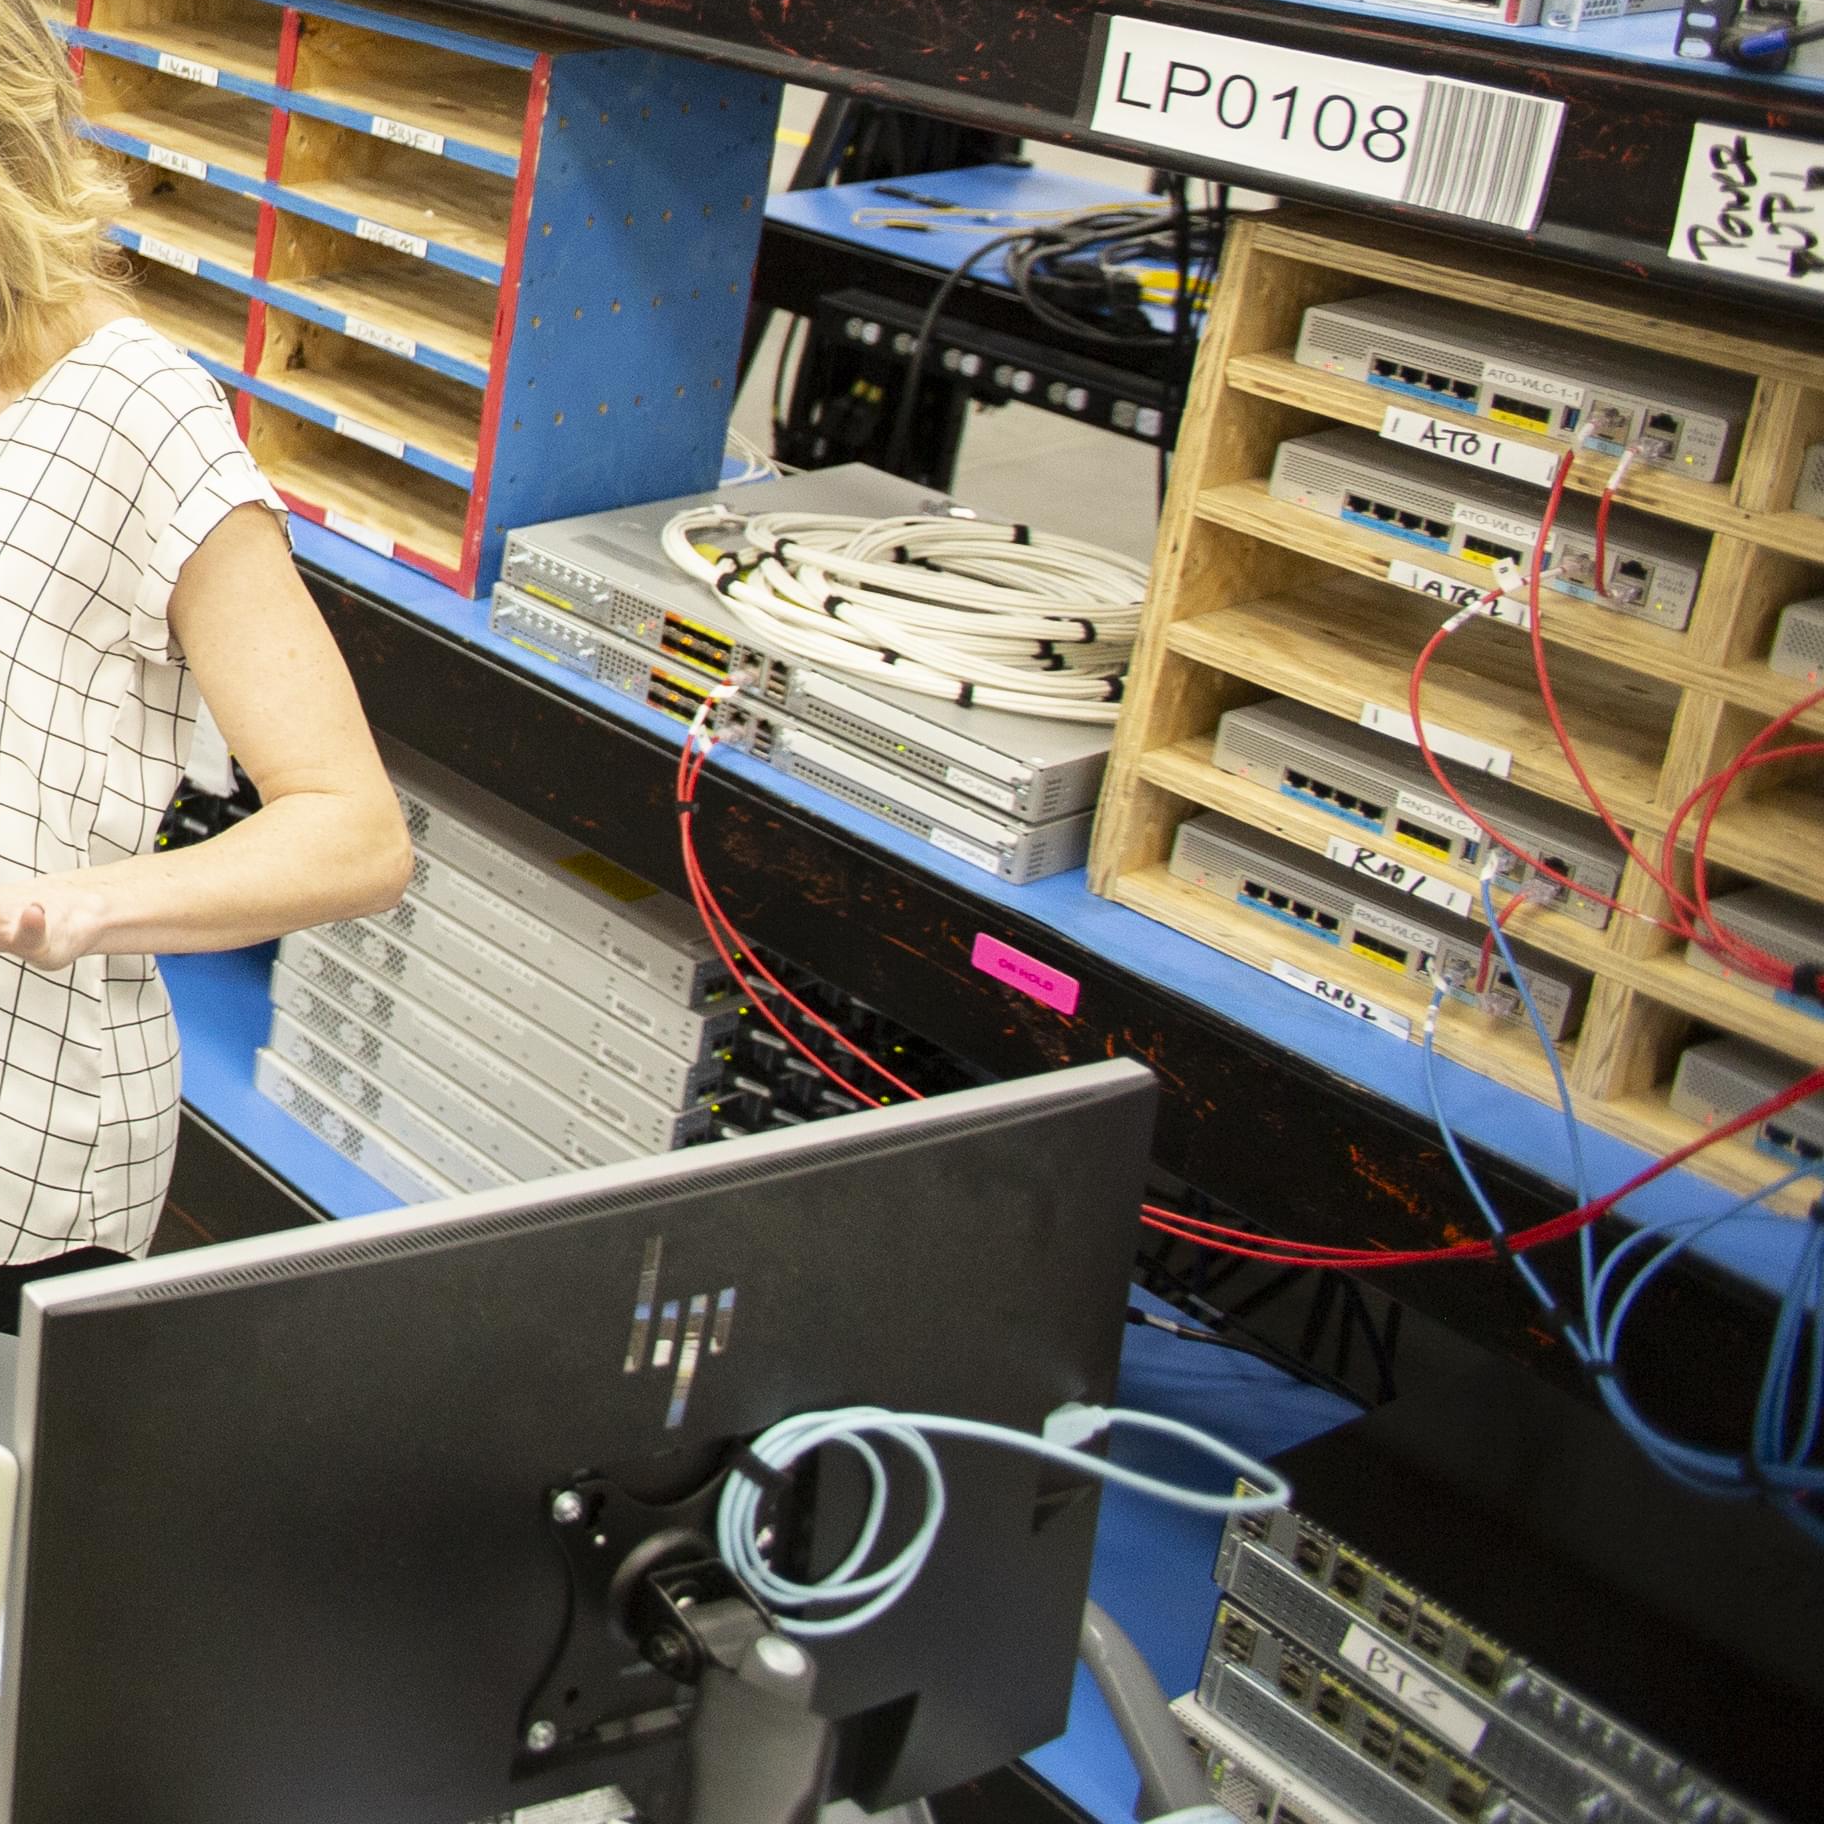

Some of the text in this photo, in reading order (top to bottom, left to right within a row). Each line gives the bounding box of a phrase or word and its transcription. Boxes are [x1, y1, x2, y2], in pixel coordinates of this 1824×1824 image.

[1116, 52, 1409, 163] LP0108
[1487, 367, 1581, 402] ATO-WLC-1-1
[1420, 419, 1481, 456] ATO
[1355, 910, 1434, 949] RNO-WLC-2
[997, 958, 1055, 992] ON HOLD
